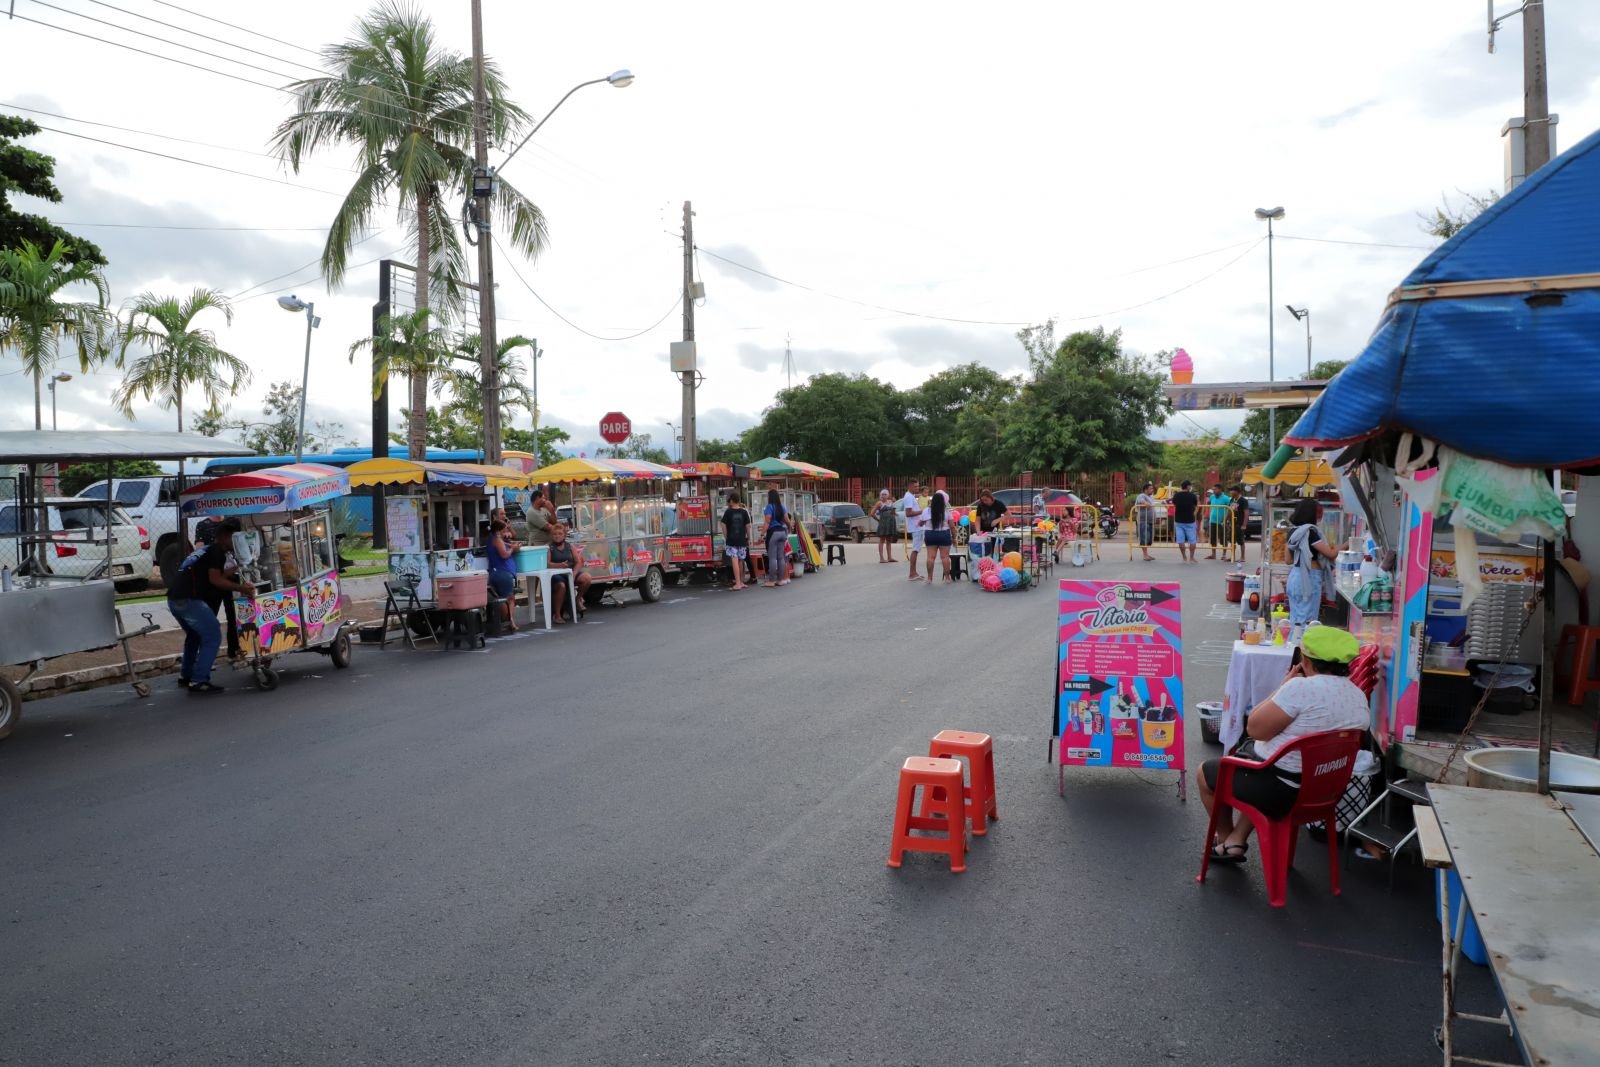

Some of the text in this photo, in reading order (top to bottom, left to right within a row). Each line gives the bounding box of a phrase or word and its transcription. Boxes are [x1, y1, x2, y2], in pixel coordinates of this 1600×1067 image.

[602, 422, 629, 434] PARE
[299, 485, 319, 500] CHURROS
[196, 494, 280, 509] CHURROS QUENTINHO
[261, 602, 297, 622] Churros
[1073, 682, 1091, 690] FRENTE
[1314, 756, 1348, 776] ITAIPAVA
